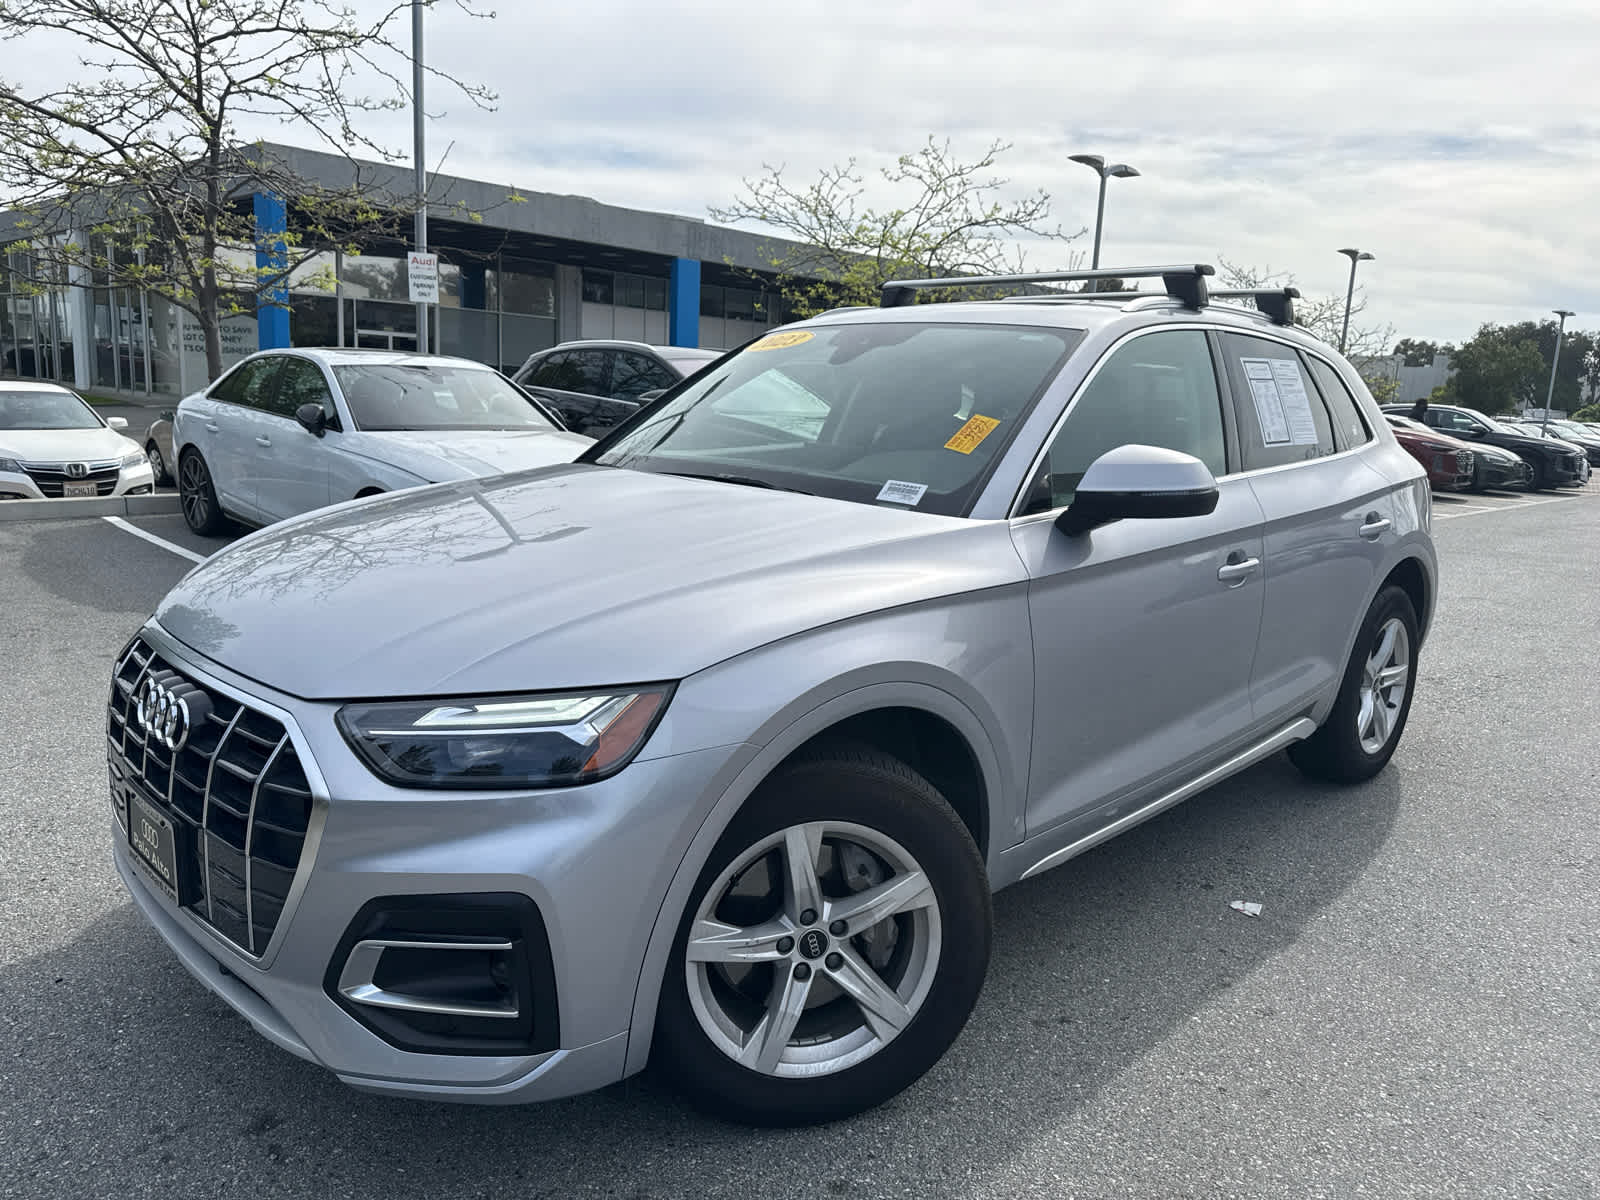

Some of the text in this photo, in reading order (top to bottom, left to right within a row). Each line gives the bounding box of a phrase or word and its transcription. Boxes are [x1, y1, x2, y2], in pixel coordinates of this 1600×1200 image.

[411, 256, 435, 265] Audi
[232, 326, 253, 334] SAVE
[133, 831, 150, 859] Palo
[151, 852, 170, 879] Alto
